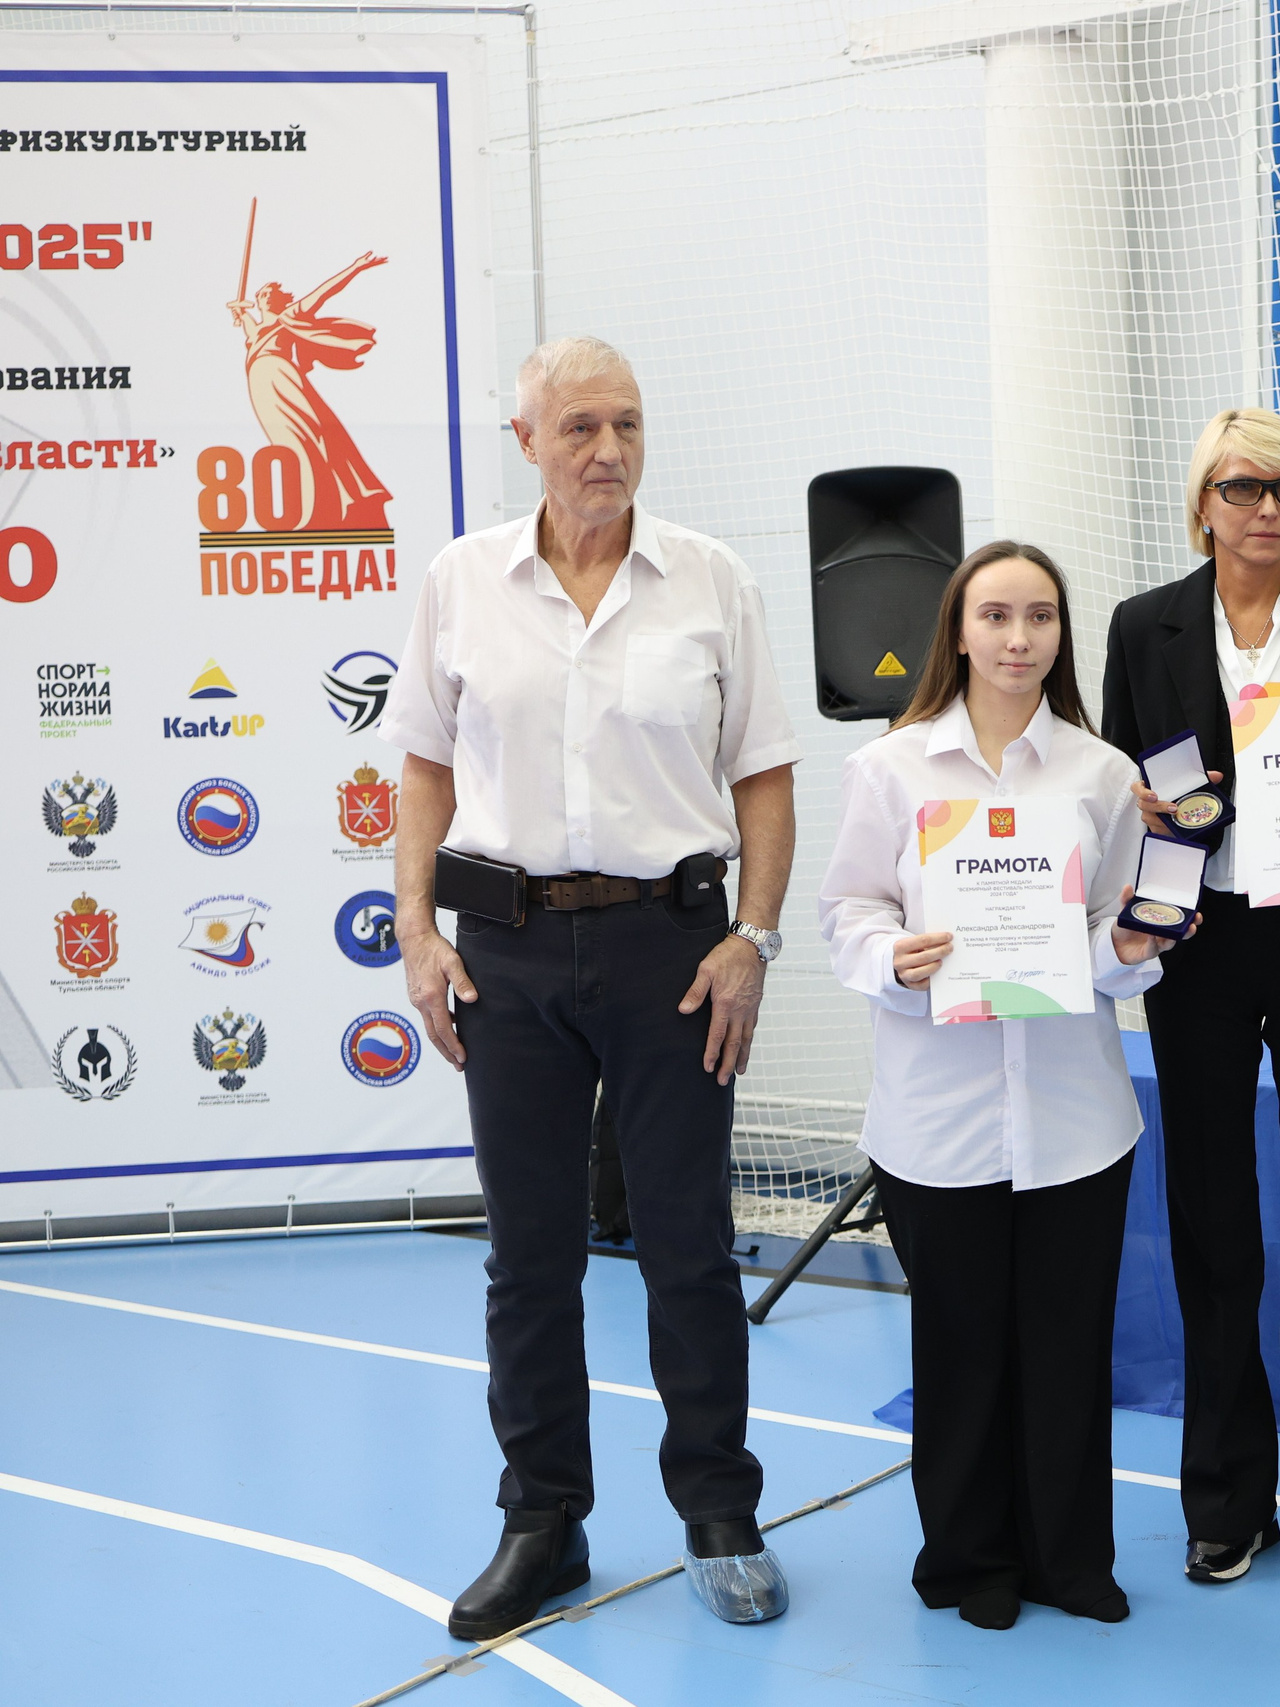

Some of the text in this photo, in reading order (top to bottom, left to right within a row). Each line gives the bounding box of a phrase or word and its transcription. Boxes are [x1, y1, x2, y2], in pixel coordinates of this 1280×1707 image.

[0, 366, 132, 391] вания
[197, 445, 303, 534] 80
[200, 548, 397, 601] ПОБЕДА!
[37, 663, 96, 680] СПОРТ
[38, 681, 111, 699] НОРМА
[39, 699, 112, 718] ЖИЗНИ
[39, 717, 112, 729] ФЕДЕРАЛЬНЫЙ
[163, 714, 265, 739] KartsUP
[40, 729, 77, 739] ПРОЕКТ
[955, 857, 1052, 874] ГРАМОТА
[247, 897, 272, 912] СОВЕТ
[1000, 923, 1055, 931] Александровна
[190, 957, 272, 977] АЙКИДО РОССИИ
